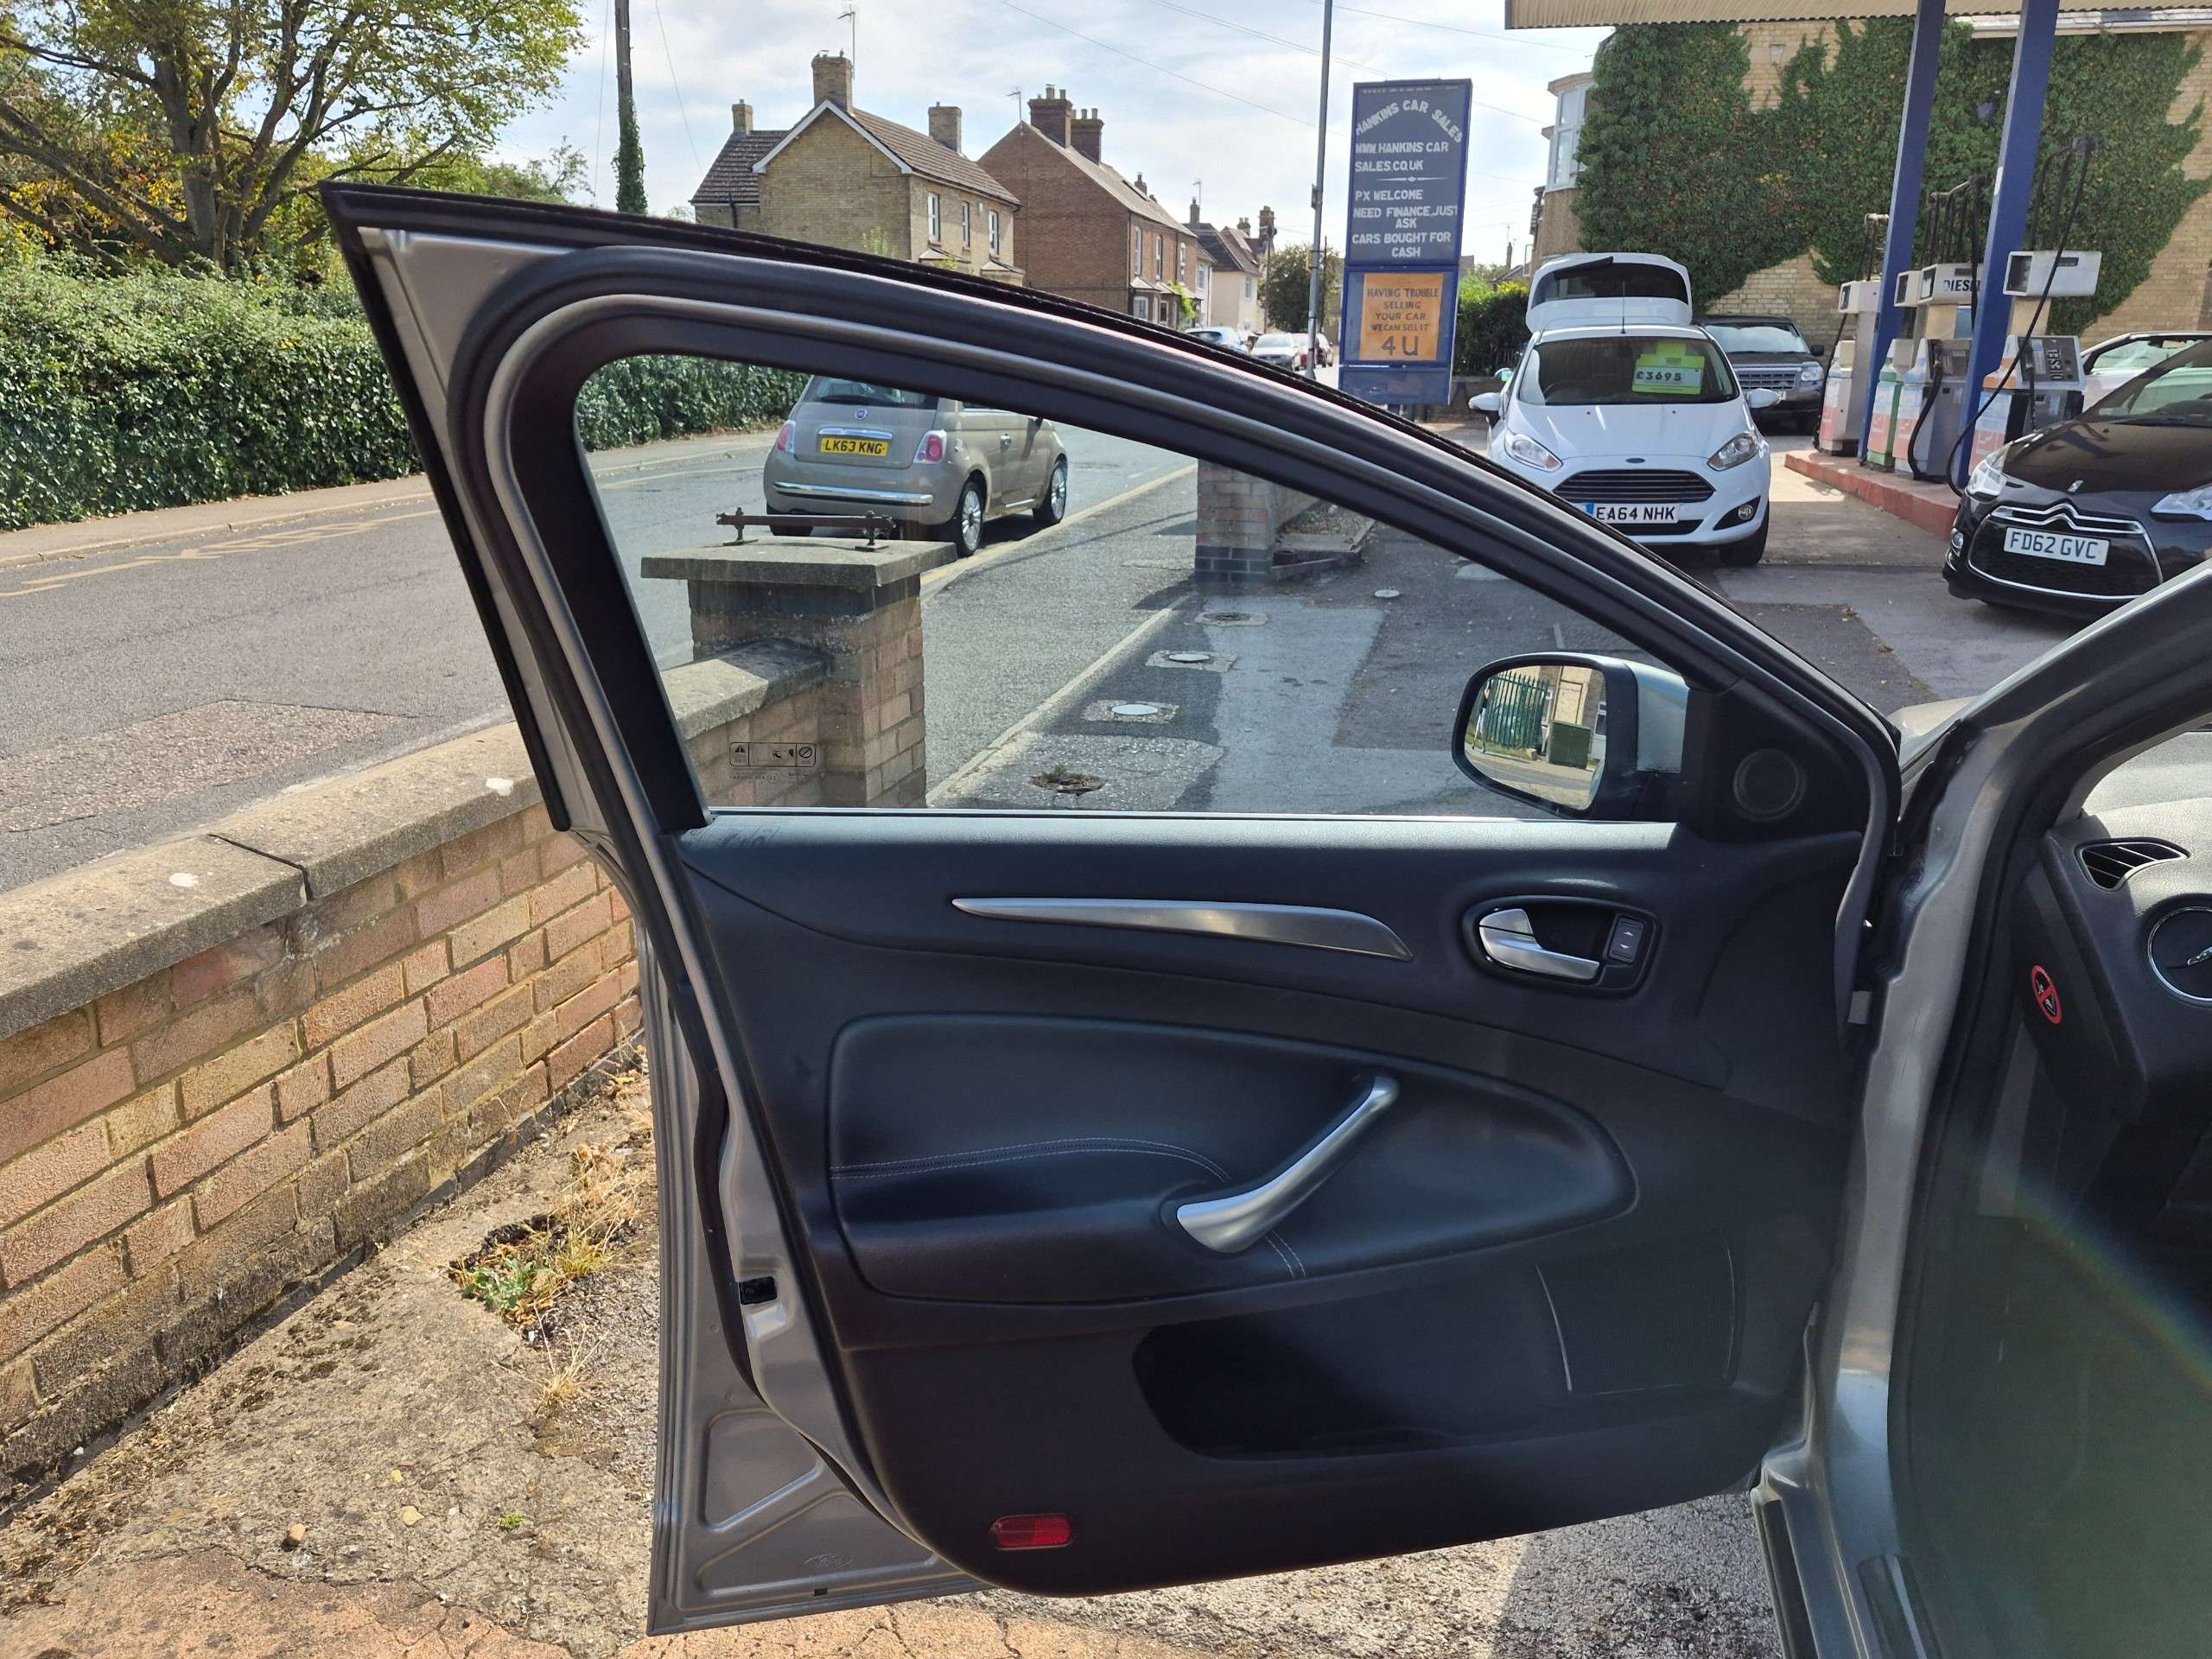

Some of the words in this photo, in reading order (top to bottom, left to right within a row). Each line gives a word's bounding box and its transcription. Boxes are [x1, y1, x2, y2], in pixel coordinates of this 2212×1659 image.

[1356, 102, 1399, 136] HANKINS
[1402, 99, 1428, 113] CAR
[1432, 110, 1462, 143] SALES
[1426, 141, 1449, 152] CAR
[1355, 191, 1370, 200] PX
[1374, 189, 1423, 200] WELCOME
[1353, 207, 1381, 218] NEED
[1395, 218, 1416, 228] ASK
[1352, 233, 1380, 244] CARS
[1384, 232, 1427, 244] BOUGHT
[1430, 232, 1451, 242] FOR
[1392, 247, 1421, 257] CASH
[1368, 288, 1401, 297] HAVING
[1403, 288, 1439, 297] TROUBLE
[1376, 312, 1402, 321] YOUR
[1405, 312, 1426, 321] CAR
[1636, 372, 1681, 382] £3695
[824, 439, 855, 452] LK63
[858, 442, 883, 454] KNG
[1596, 506, 1637, 520] EA64
[1643, 506, 1675, 520] NHK
[2010, 531, 2056, 554] FD62
[2060, 538, 2098, 559] GVC
